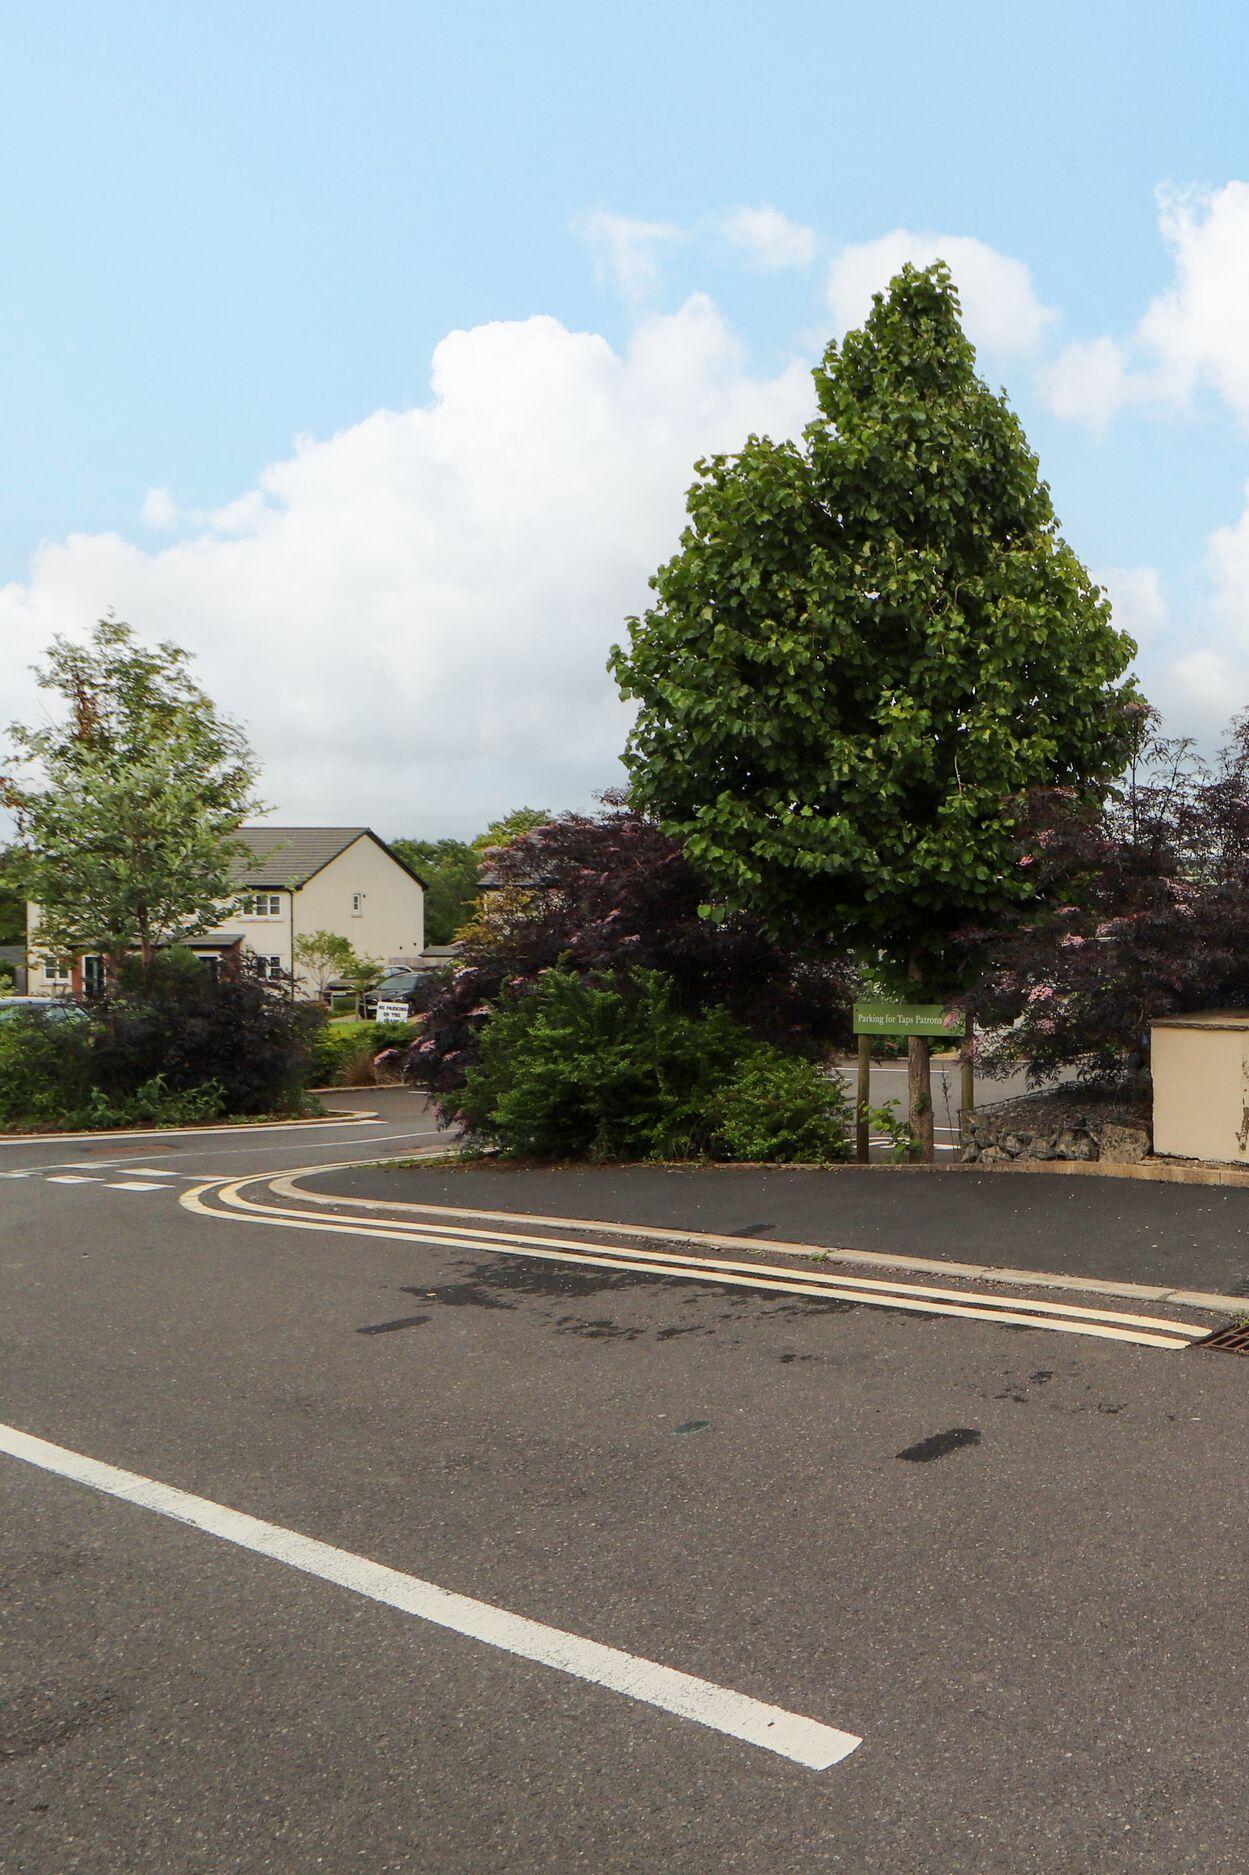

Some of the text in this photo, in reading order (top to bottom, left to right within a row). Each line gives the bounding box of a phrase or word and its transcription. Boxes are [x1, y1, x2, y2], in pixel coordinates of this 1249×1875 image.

[858, 1014, 942, 1026] Parking for Taps Patrons
